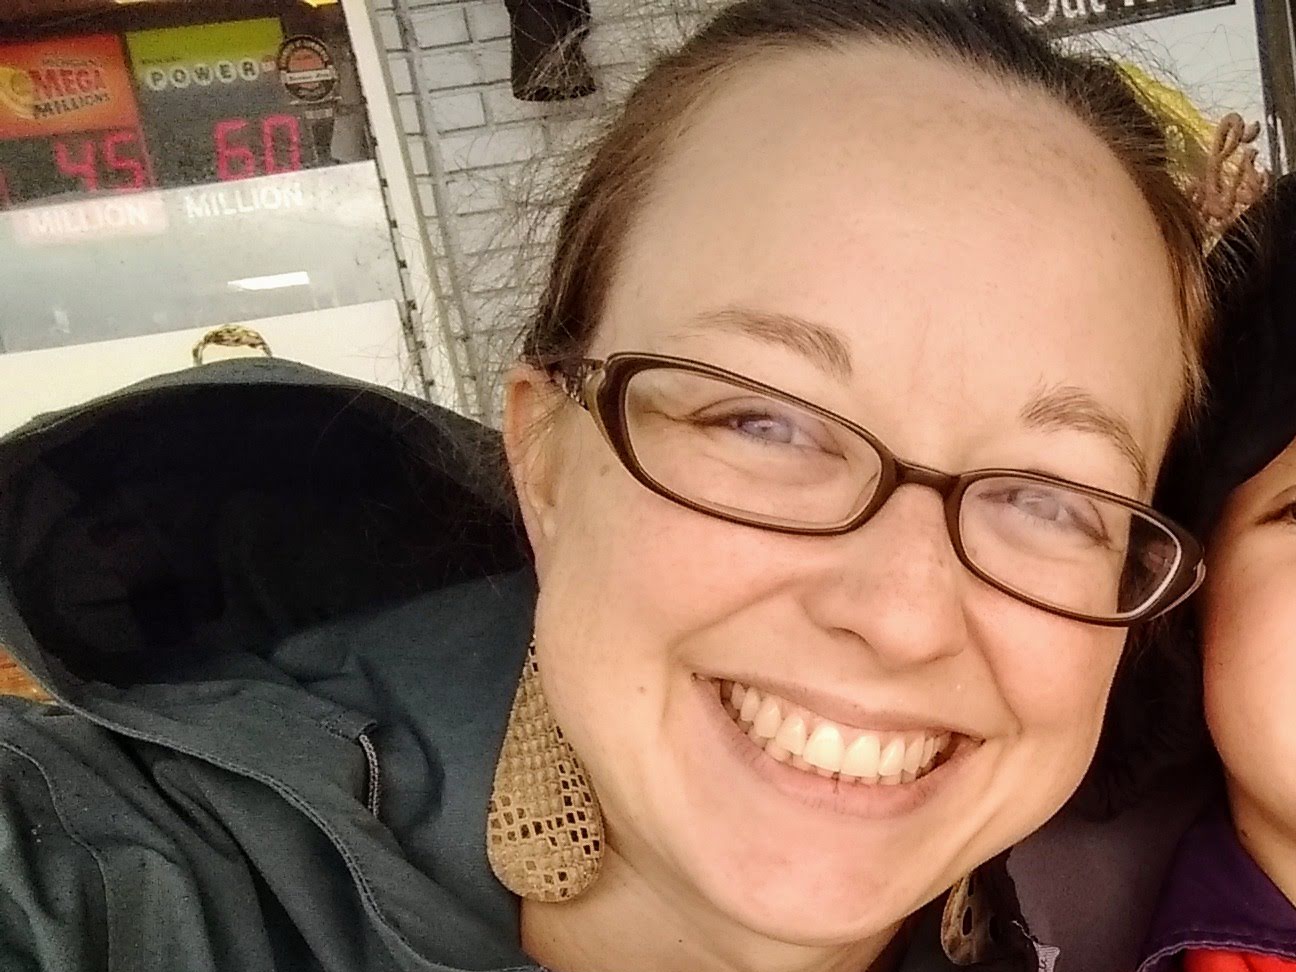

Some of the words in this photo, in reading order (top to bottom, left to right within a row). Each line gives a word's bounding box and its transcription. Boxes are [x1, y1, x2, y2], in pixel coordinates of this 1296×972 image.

[28, 67, 107, 98] MEGA
[147, 59, 259, 89] POWER
[54, 131, 145, 192] 45
[214, 114, 300, 181] 60
[28, 201, 149, 234] MILLION
[184, 183, 303, 219] MILLION
